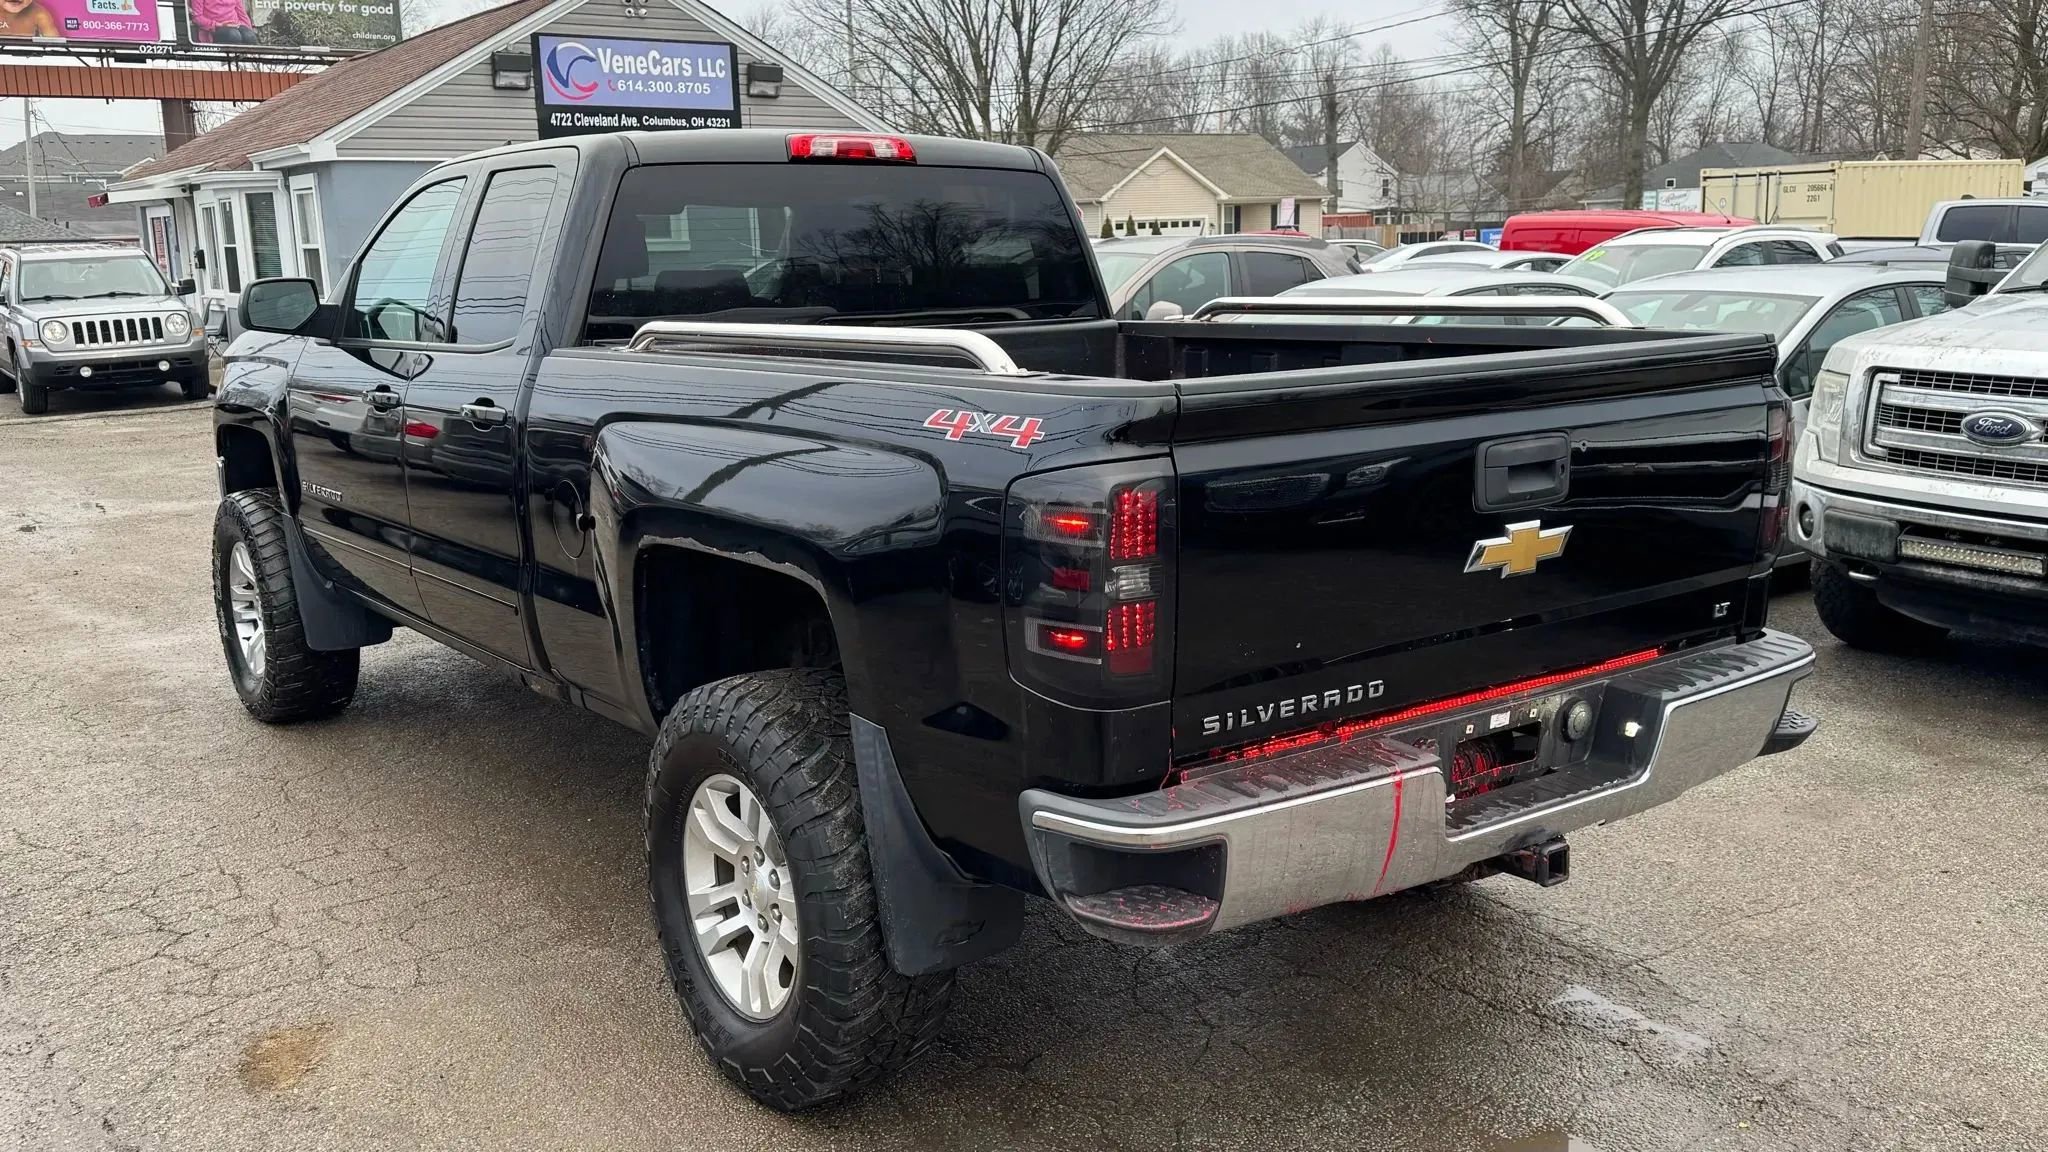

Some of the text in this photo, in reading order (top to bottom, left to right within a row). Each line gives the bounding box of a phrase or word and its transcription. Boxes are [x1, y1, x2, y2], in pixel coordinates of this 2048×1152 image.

[92, 0, 120, 9] Facts.
[255, 0, 394, 16] End poverty for good
[82, 20, 150, 31] 800-366-7773
[352, 32, 396, 42] children.org
[139, 45, 173, 54] 021271
[597, 47, 726, 78] VeneCars LLC
[617, 79, 711, 95] 614.300.8705
[550, 112, 730, 128] 4722 Cleveland Ave. Columbus, OH 43231
[1974, 417, 2012, 435] Ford
[1714, 602, 1731, 618] LT
[1202, 679, 1385, 736] SILVERADO
